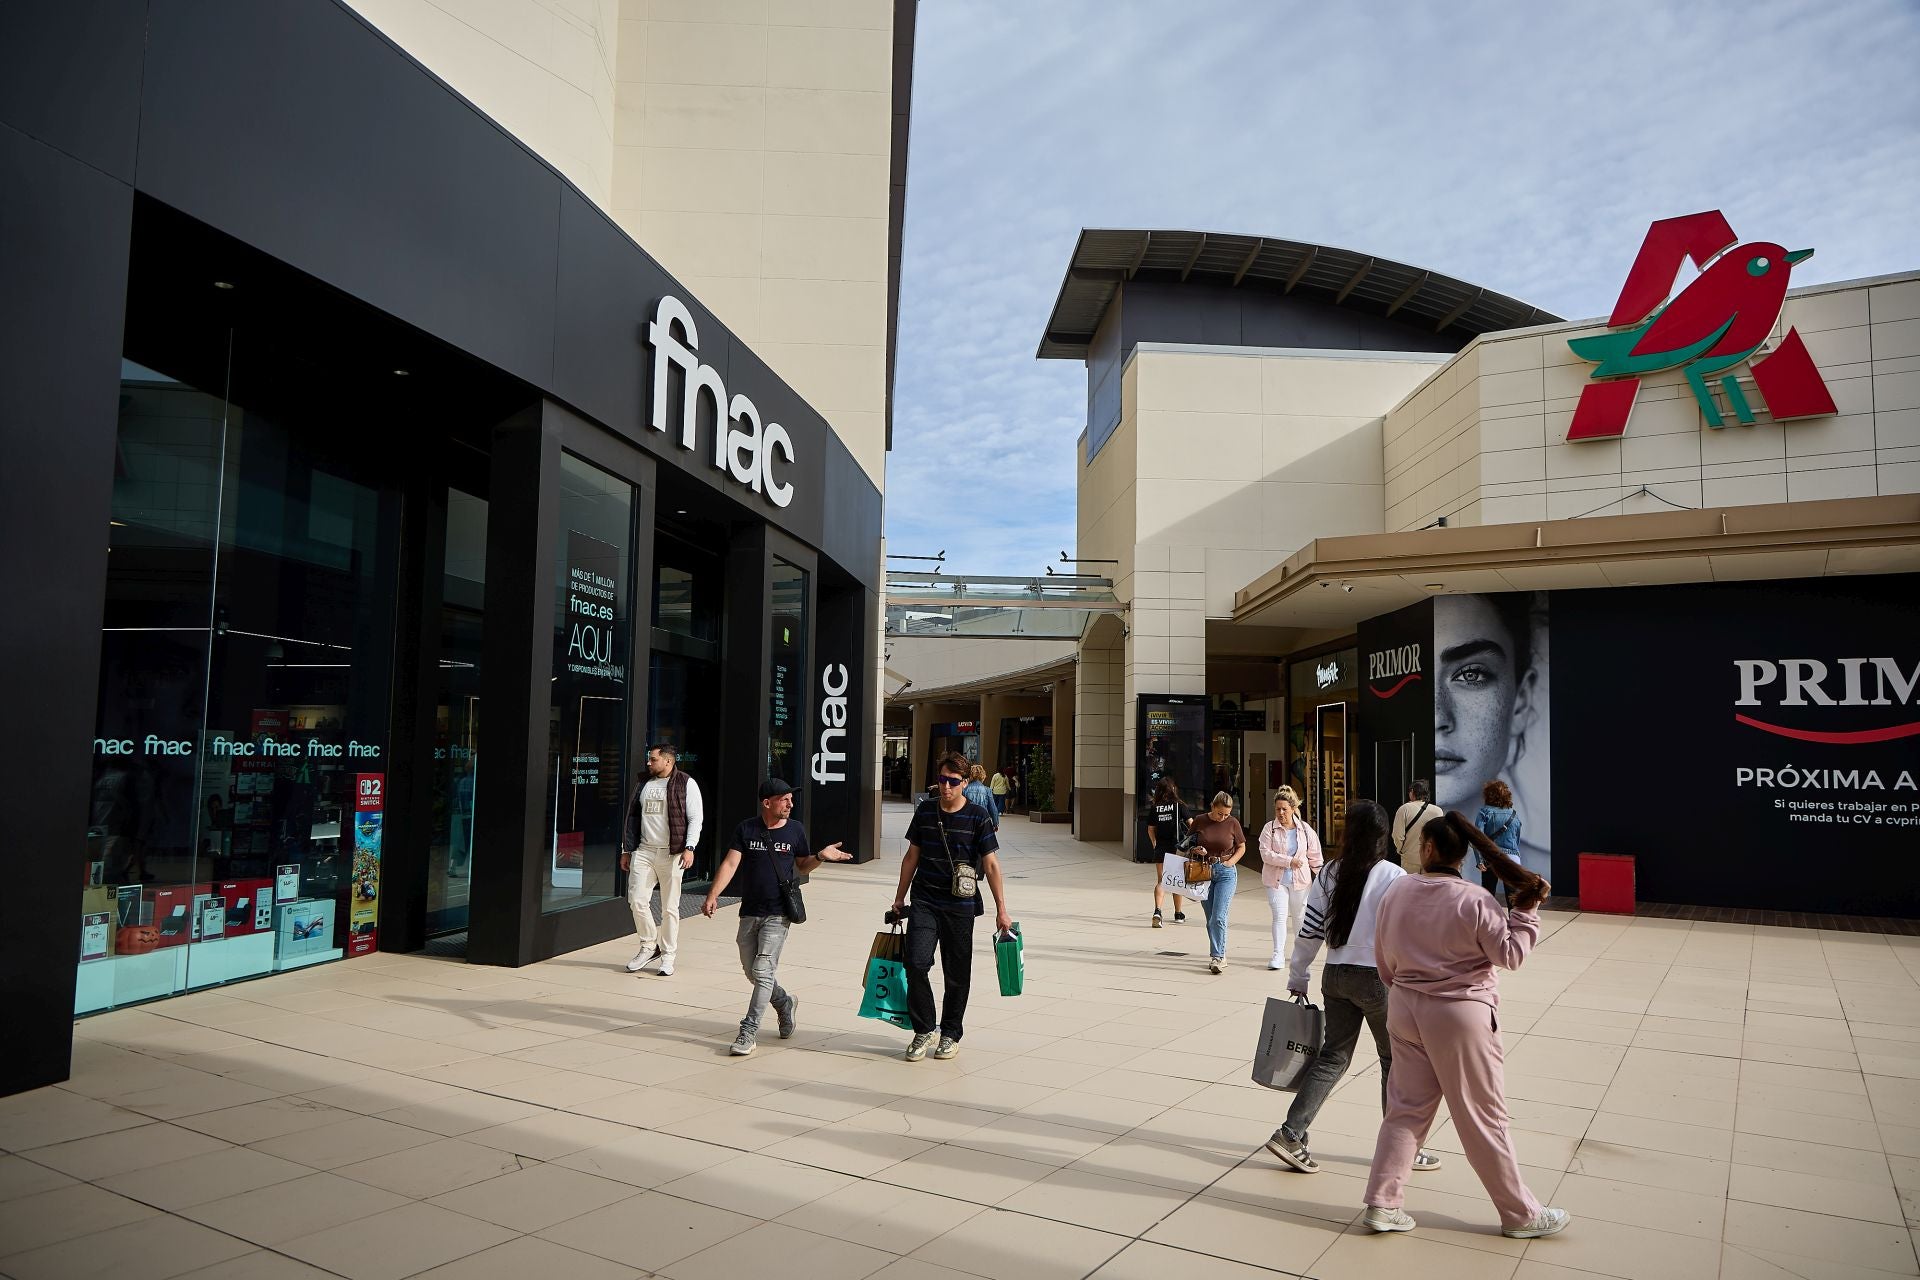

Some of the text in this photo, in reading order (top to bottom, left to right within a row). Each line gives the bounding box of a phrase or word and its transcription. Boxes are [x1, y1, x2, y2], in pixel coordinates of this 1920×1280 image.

[649, 296, 794, 508] fnac
[572, 567, 614, 588] MÁS DE 1 MILLÓN
[571, 581, 614, 601] DE PRODUCTOS DE
[570, 594, 613, 620] fnac.es
[568, 622, 613, 663] AQUÍ
[1369, 644, 1422, 680] PRIMOR
[1734, 658, 1920, 705] PRIM
[811, 664, 848, 785] fnac
[144, 734, 192, 755] fnac
[213, 736, 255, 756] fnac
[263, 738, 301, 756] fnac
[307, 738, 344, 757] fnac
[348, 740, 381, 757] fnac
[372, 780, 381, 794] 2
[1736, 764, 1918, 790] PRÓXIMA A
[1156, 804, 1174, 812] TEAM
[1774, 799, 1785, 808] Si
[1788, 800, 1834, 811] quieres
[1838, 802, 1887, 813] trabajar
[1790, 813, 1833, 822] manda
[1836, 815, 1849, 823] tu
[1853, 815, 1872, 824] CV
